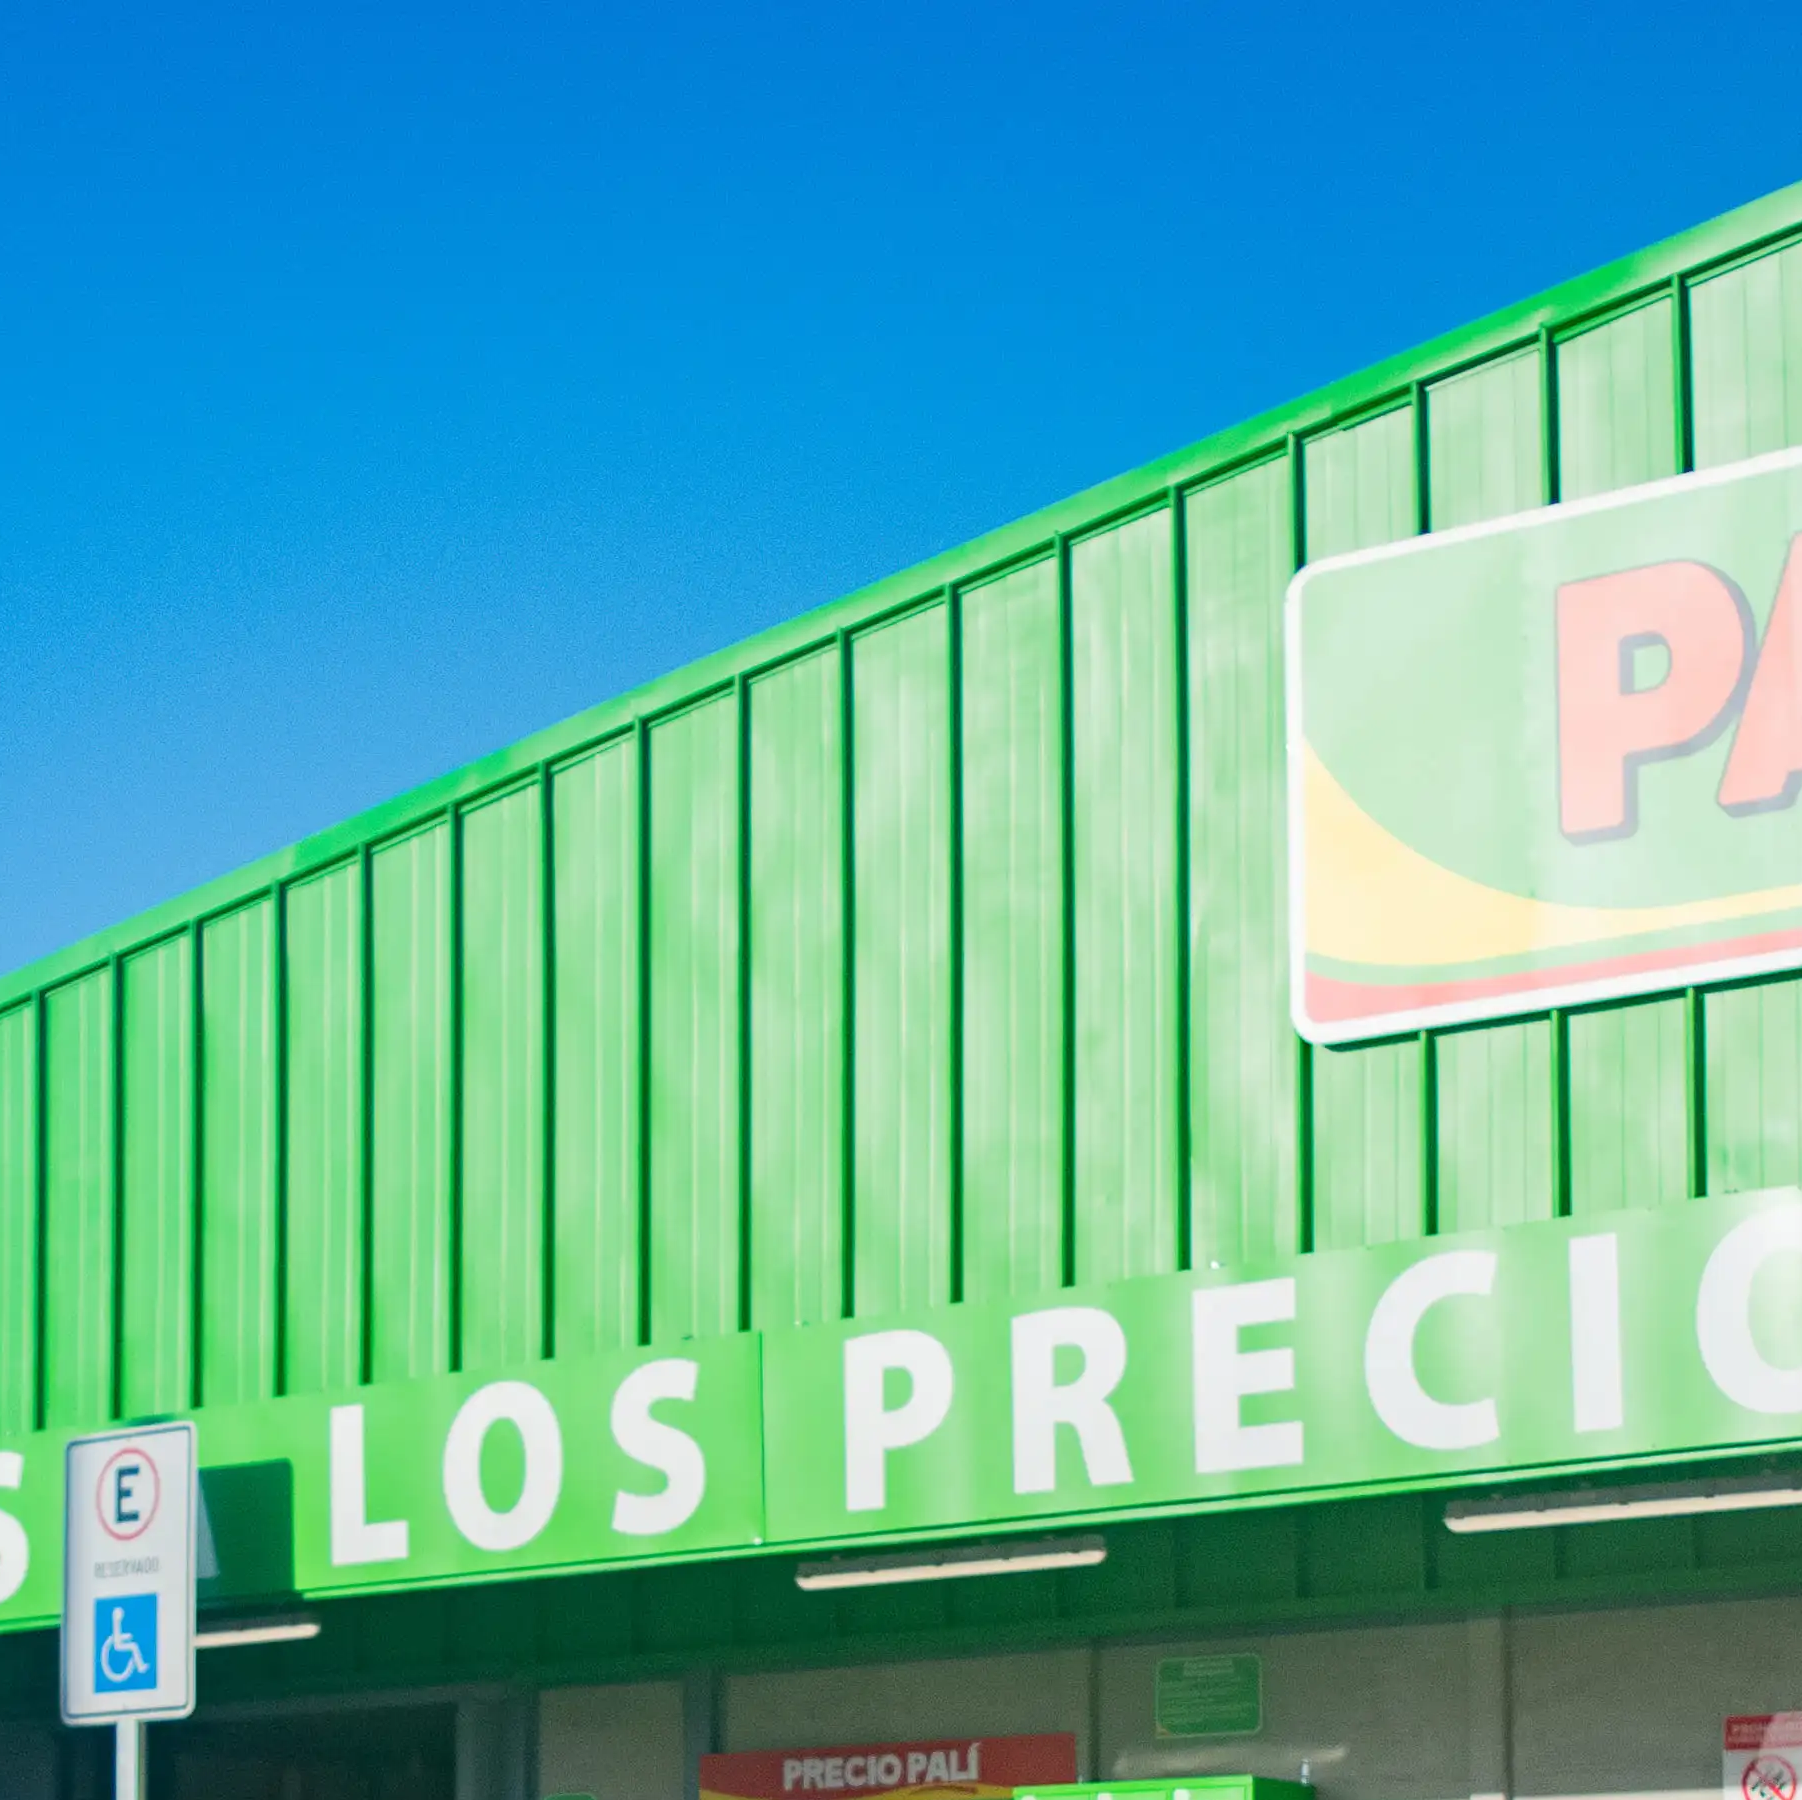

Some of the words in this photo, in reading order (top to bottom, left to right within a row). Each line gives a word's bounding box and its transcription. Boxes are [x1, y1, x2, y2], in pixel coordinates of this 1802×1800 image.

[328, 1357, 707, 1567] LOS
[115, 1464, 141, 1524] E
[782, 1753, 903, 1791] PRECIO
[906, 1742, 981, 1784] PALÍ
